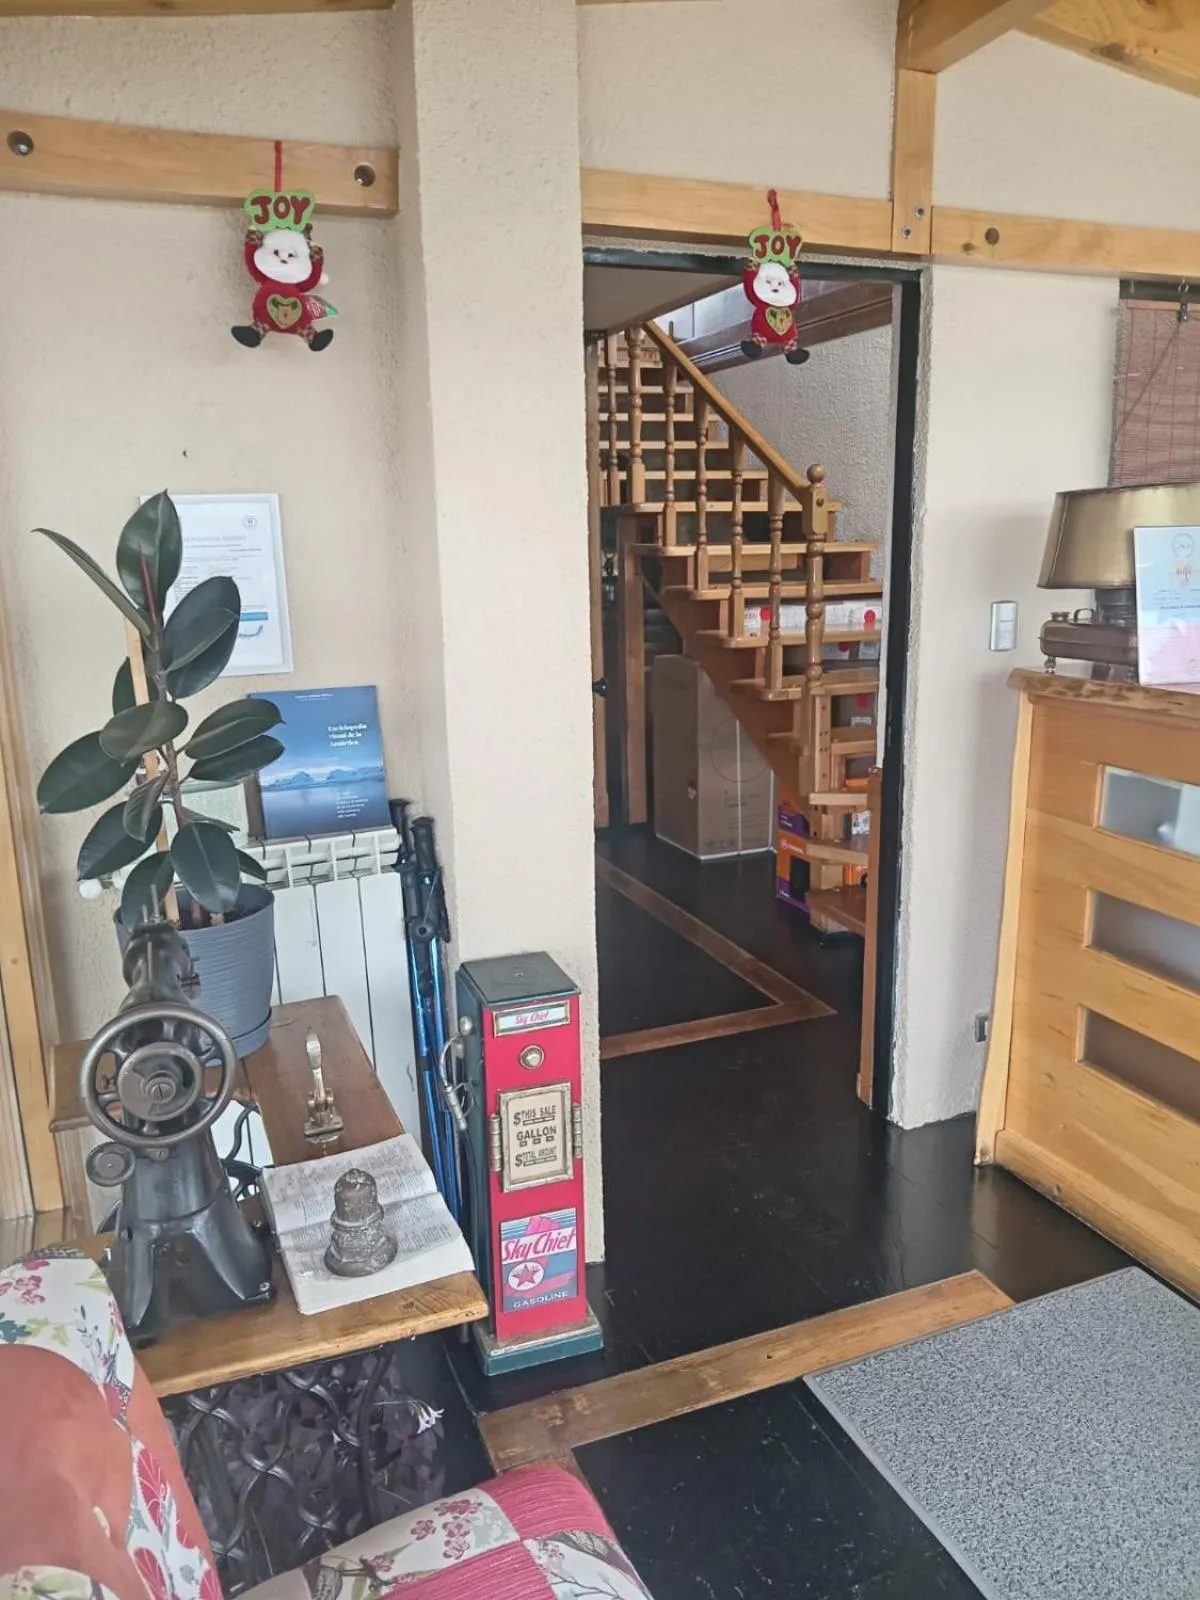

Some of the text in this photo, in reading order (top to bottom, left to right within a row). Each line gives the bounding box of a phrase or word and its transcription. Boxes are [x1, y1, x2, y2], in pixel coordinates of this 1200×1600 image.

[251, 195, 311, 224] JOY
[754, 234, 802, 259] JOY
[515, 1010, 550, 1025] Sky Chief
[540, 1105, 557, 1117] SALE
[517, 1126, 557, 1141] GALLON
[504, 1230, 576, 1260] Sky Chief
[513, 1291, 569, 1308] GASOLINE
